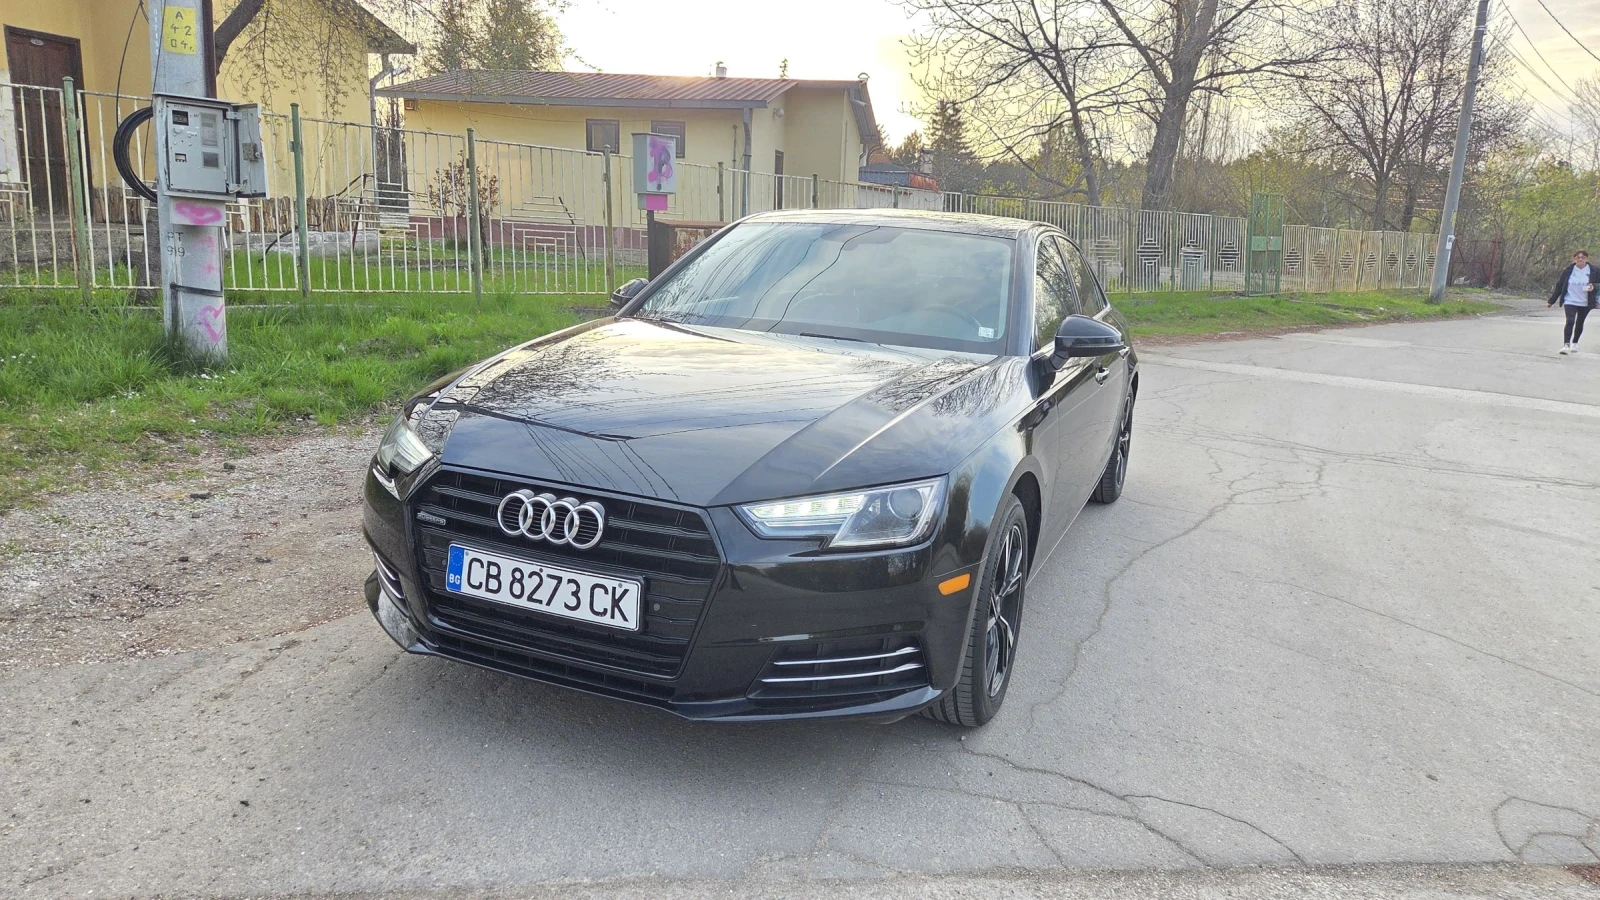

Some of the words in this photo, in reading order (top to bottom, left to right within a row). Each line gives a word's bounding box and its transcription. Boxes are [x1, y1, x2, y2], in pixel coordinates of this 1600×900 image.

[175, 11, 184, 20] A
[449, 573, 461, 585] BG
[467, 557, 502, 595] CB
[509, 566, 582, 612] 8273
[589, 583, 630, 623] CK
